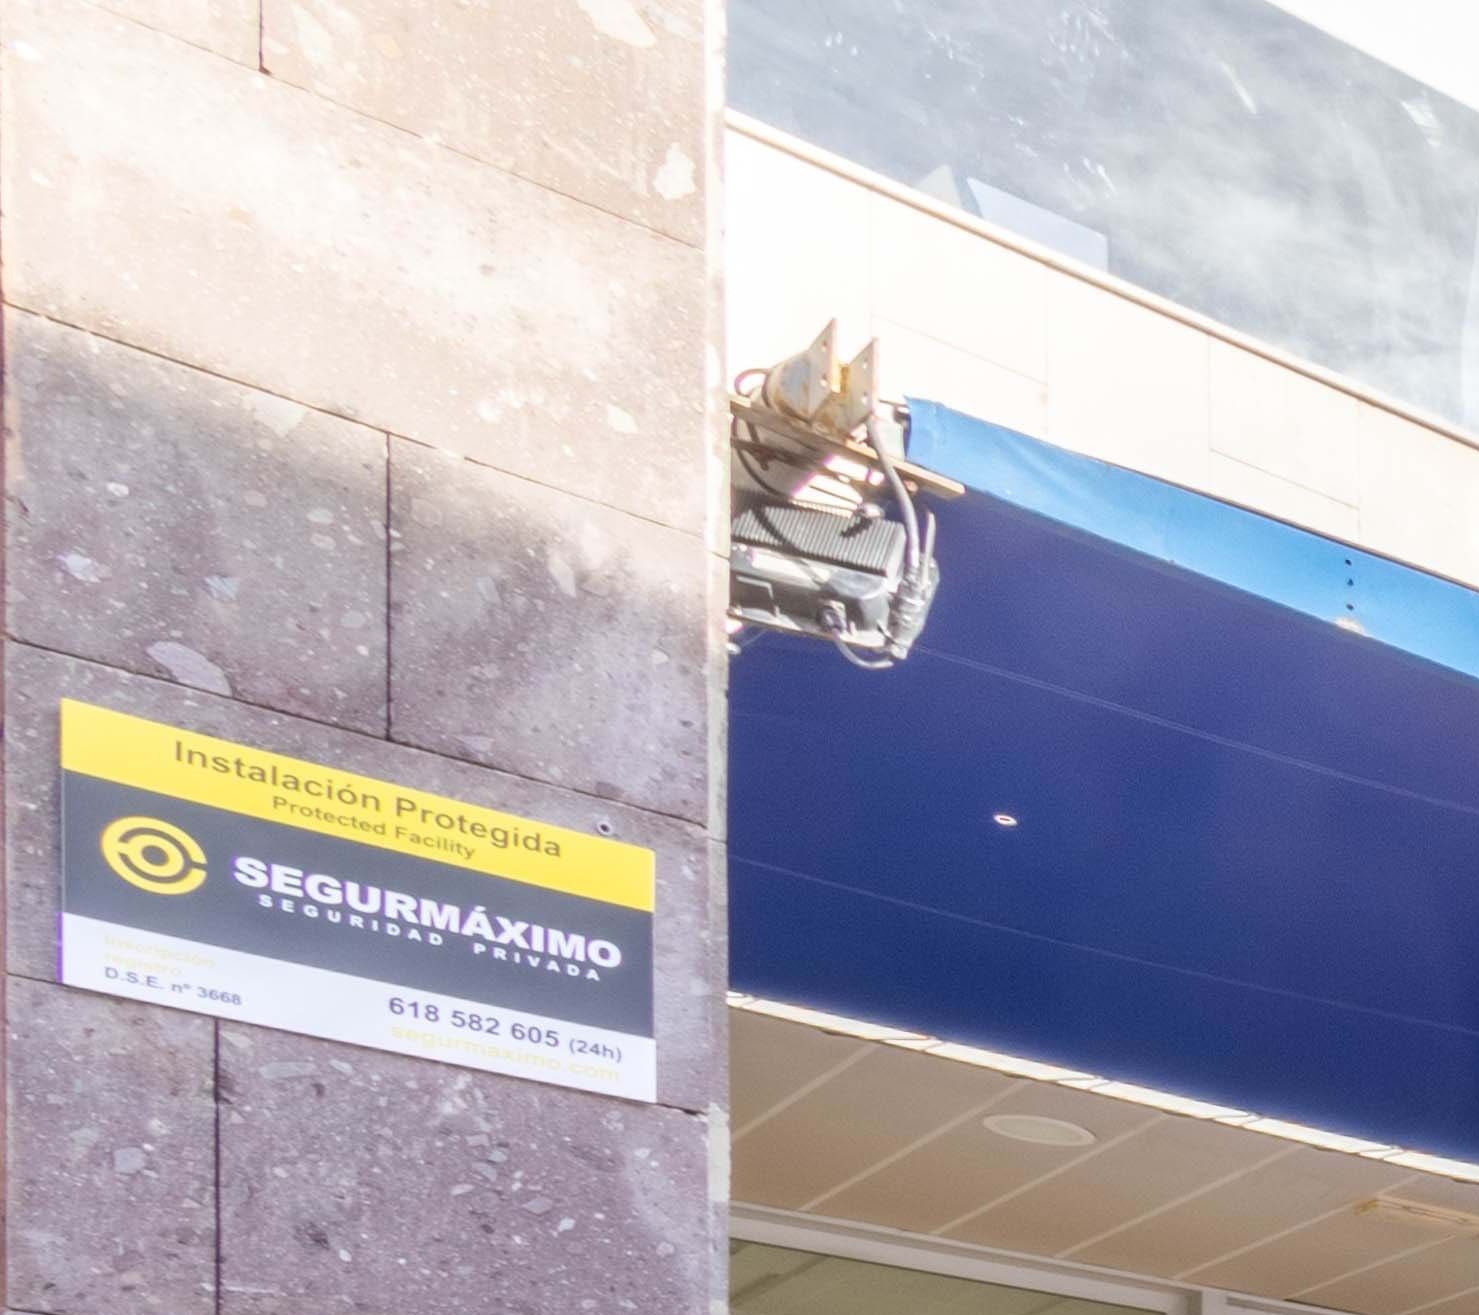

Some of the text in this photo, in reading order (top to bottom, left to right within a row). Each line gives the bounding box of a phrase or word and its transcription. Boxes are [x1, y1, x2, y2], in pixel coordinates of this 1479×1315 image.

[175, 740, 562, 857] Instalación Protegida
[272, 796, 476, 860] Protected Facility
[233, 856, 622, 968] SEGURMÁXIMO
[259, 894, 601, 982] SEGURIDAD PRIVADA
[389, 997, 622, 1063] 618 582 605 (24h)
